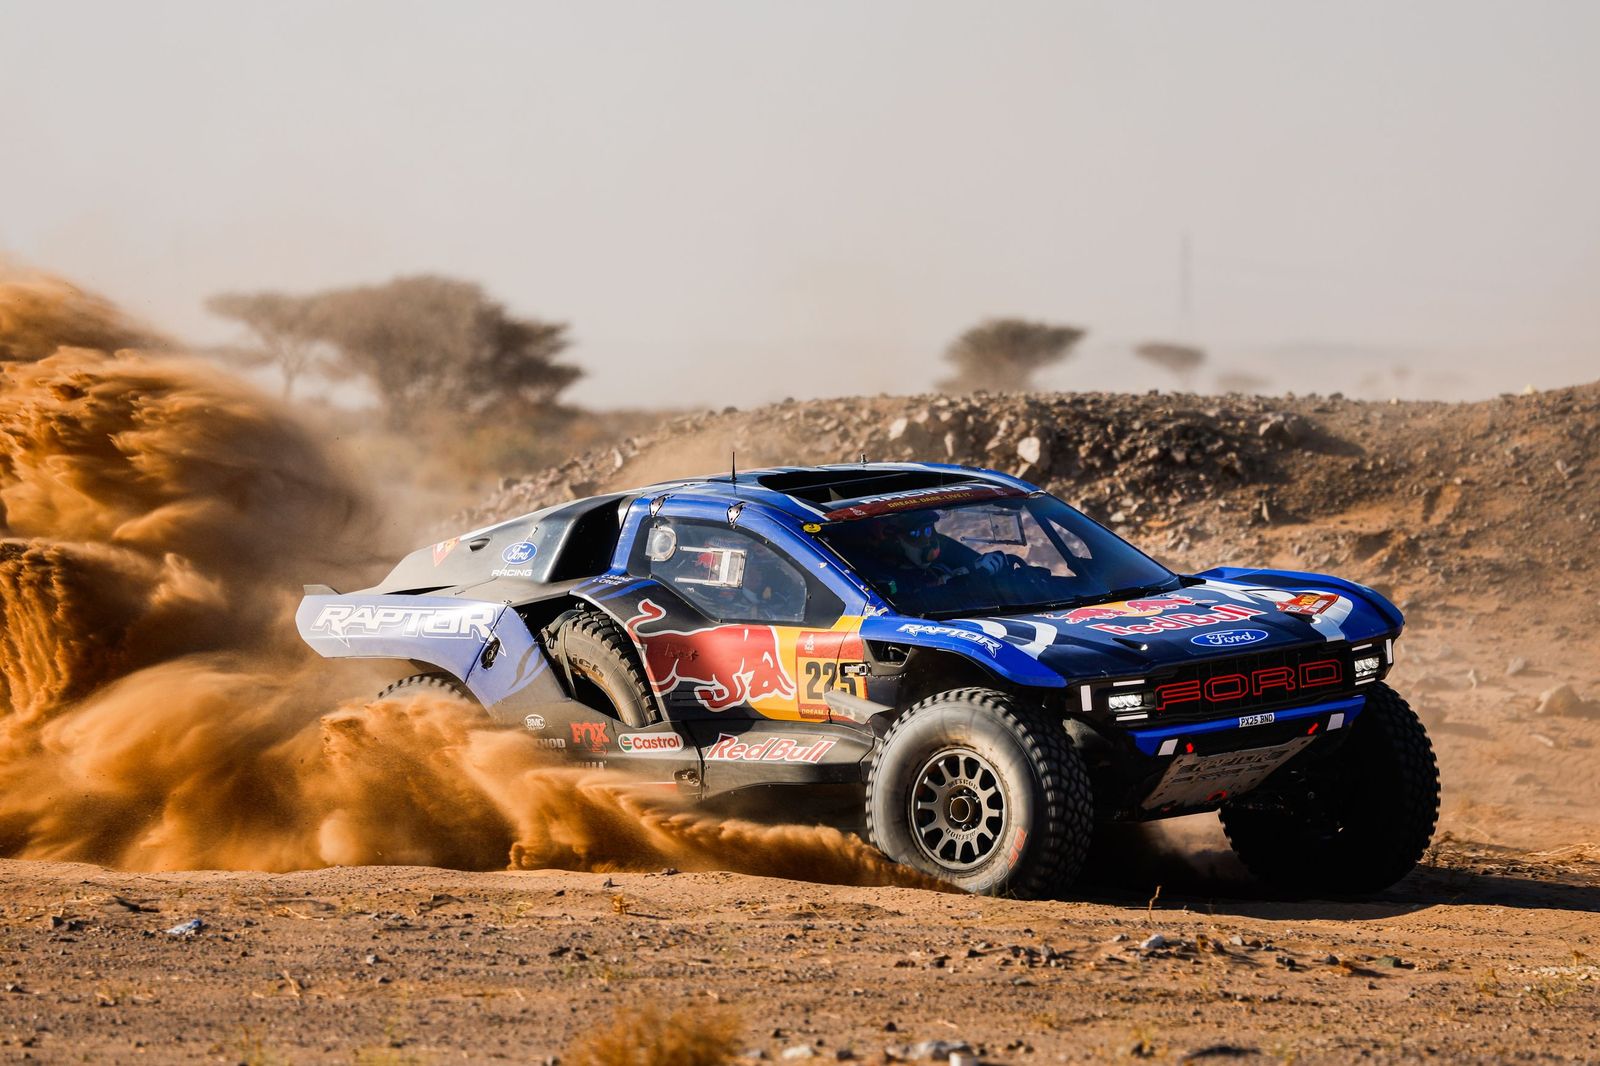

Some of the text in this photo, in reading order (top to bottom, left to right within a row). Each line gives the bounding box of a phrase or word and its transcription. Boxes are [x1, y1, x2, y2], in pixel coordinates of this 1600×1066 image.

[507, 542, 533, 561] Ford
[491, 568, 533, 577] RACING
[310, 604, 507, 656] RAPTOR
[896, 623, 1003, 659] RAPTOR
[1207, 631, 1255, 645] Ford
[805, 661, 858, 700] 225
[1155, 659, 1343, 711] FORD
[569, 721, 610, 750] FOX
[632, 734, 680, 750] Castrol
[706, 733, 840, 763] Red Bull
